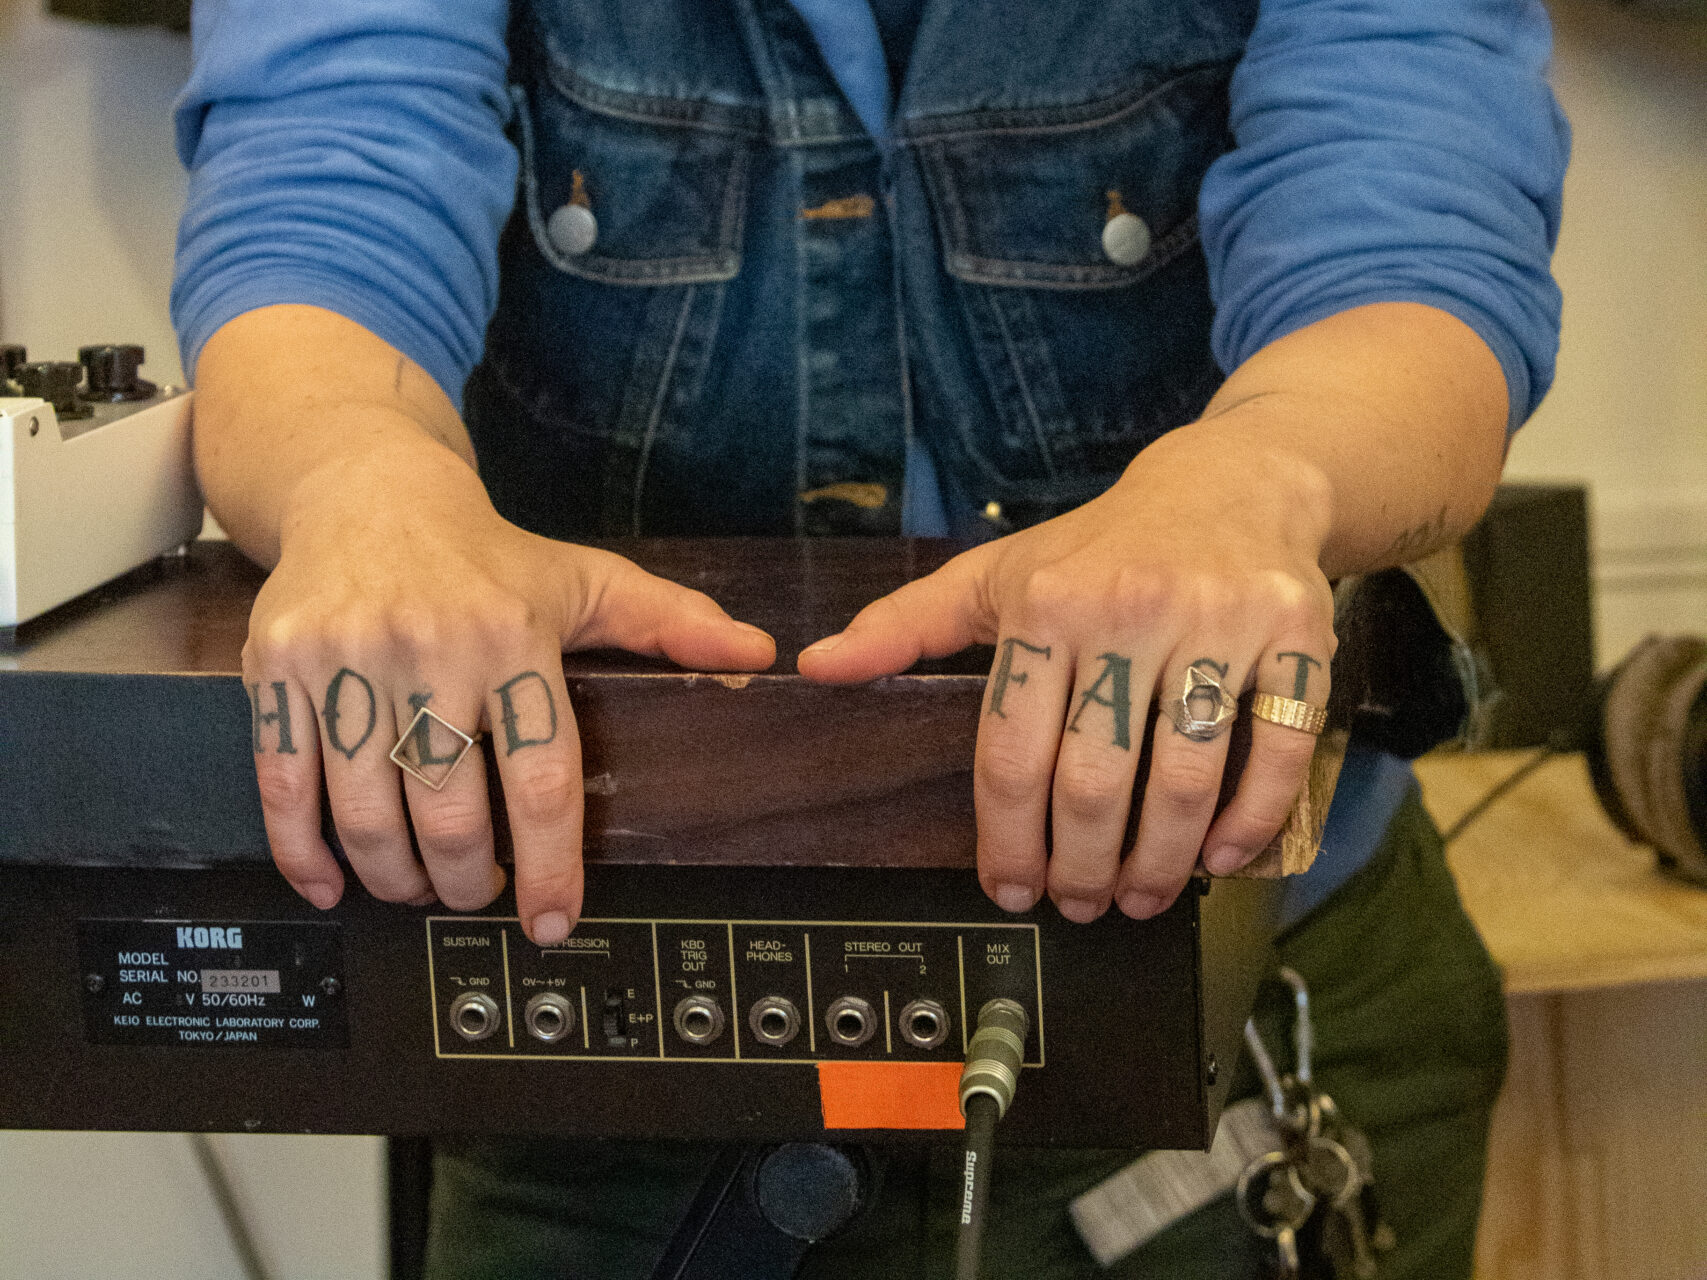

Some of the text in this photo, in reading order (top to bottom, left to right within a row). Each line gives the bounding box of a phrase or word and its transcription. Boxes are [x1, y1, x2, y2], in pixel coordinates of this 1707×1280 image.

[988, 637, 1322, 751] FAST
[250, 666, 558, 760] HOLD
[177, 927, 243, 949] KORG
[443, 936, 490, 947] SUSTAIN
[541, 937, 610, 949] RESSION
[681, 940, 706, 950] KBD
[750, 940, 786, 951] HEAD-
[844, 942, 923, 953] STEREO OUT
[987, 944, 1010, 953] MIX
[118, 952, 169, 965] MODEL
[681, 951, 708, 961] TRIG
[746, 951, 793, 963] PHONES
[987, 954, 1011, 965] OUT
[682, 962, 706, 972] OUT
[844, 964, 849, 973] 1
[919, 965, 927, 975] 2
[119, 970, 269, 988] SERIAL NO. 233201
[469, 977, 490, 986] GND
[695, 980, 716, 990] GND
[627, 989, 635, 998] E
[122, 992, 315, 1007] AC V 50/60Hz W
[114, 1015, 320, 1029] KEIO ELECTRONIC LABORATORY CORP.
[629, 1013, 653, 1024] E+P
[631, 1038, 638, 1047] P
[961, 1150, 977, 1225] Supreme
